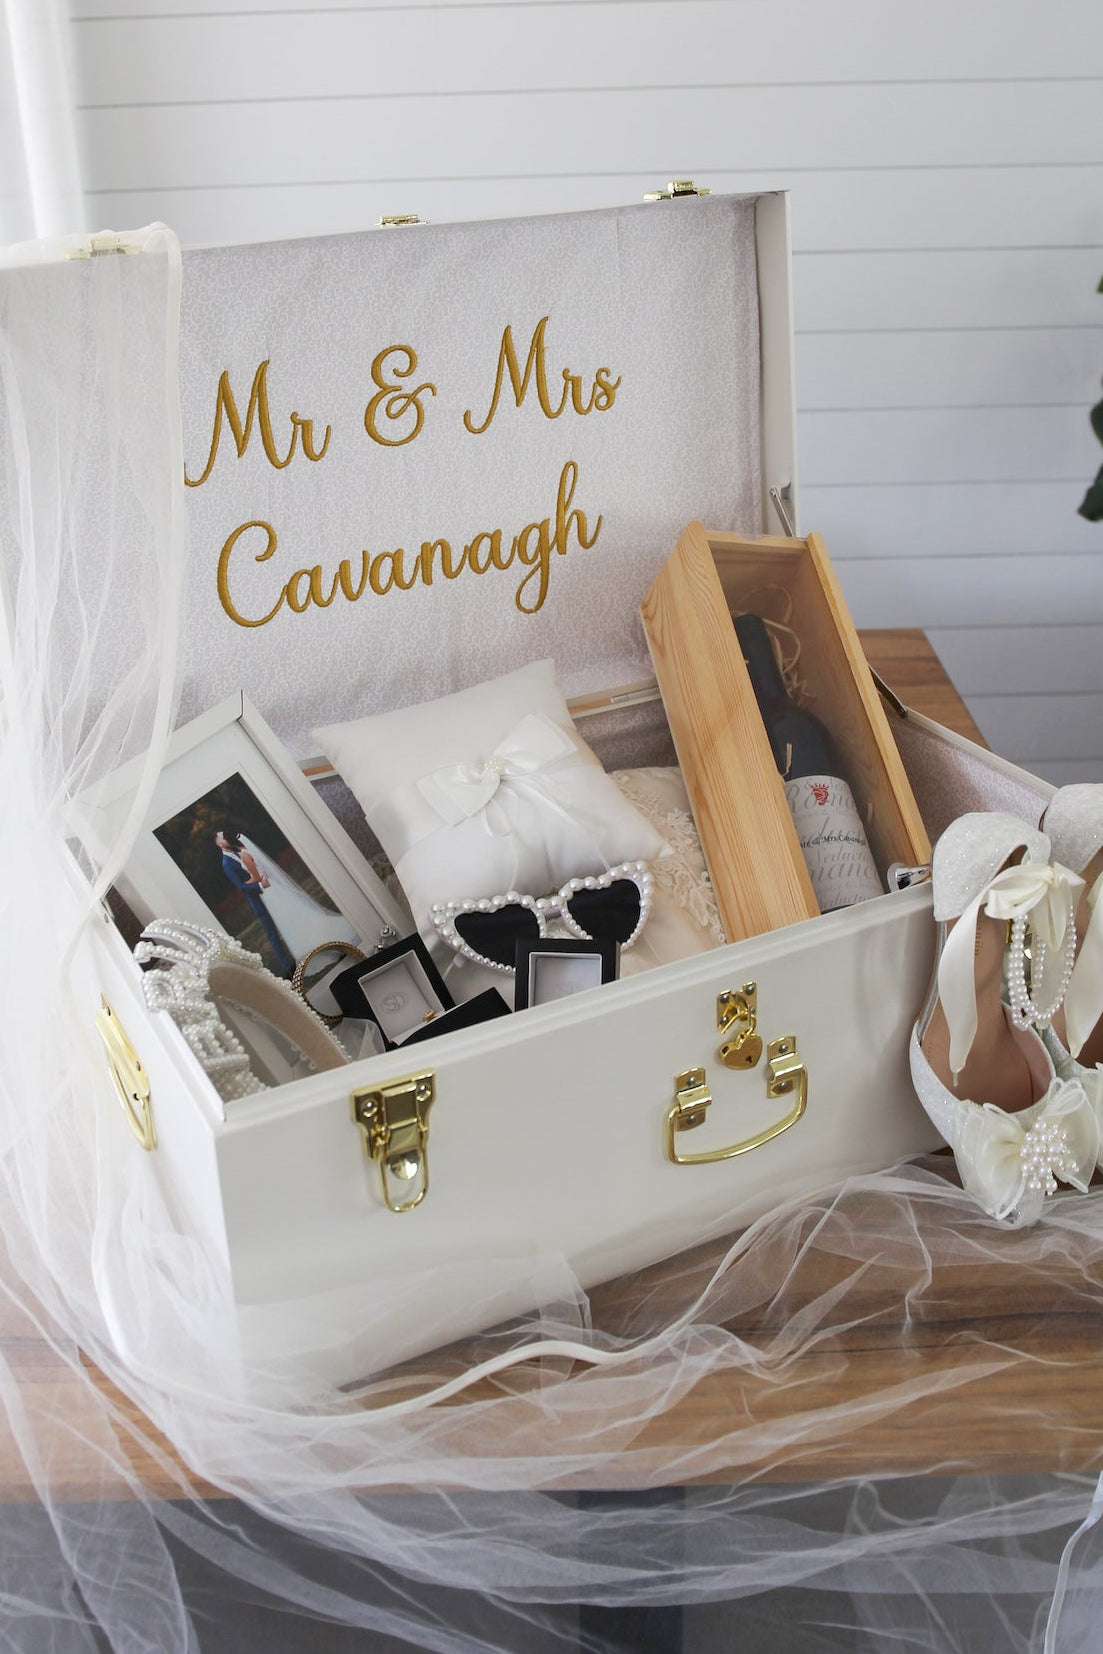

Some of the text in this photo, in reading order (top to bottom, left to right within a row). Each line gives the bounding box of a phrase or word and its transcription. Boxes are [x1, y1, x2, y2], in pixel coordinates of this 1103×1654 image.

[183, 316, 622, 488] Mr & Mrs
[216, 460, 603, 628] Cavanagh
